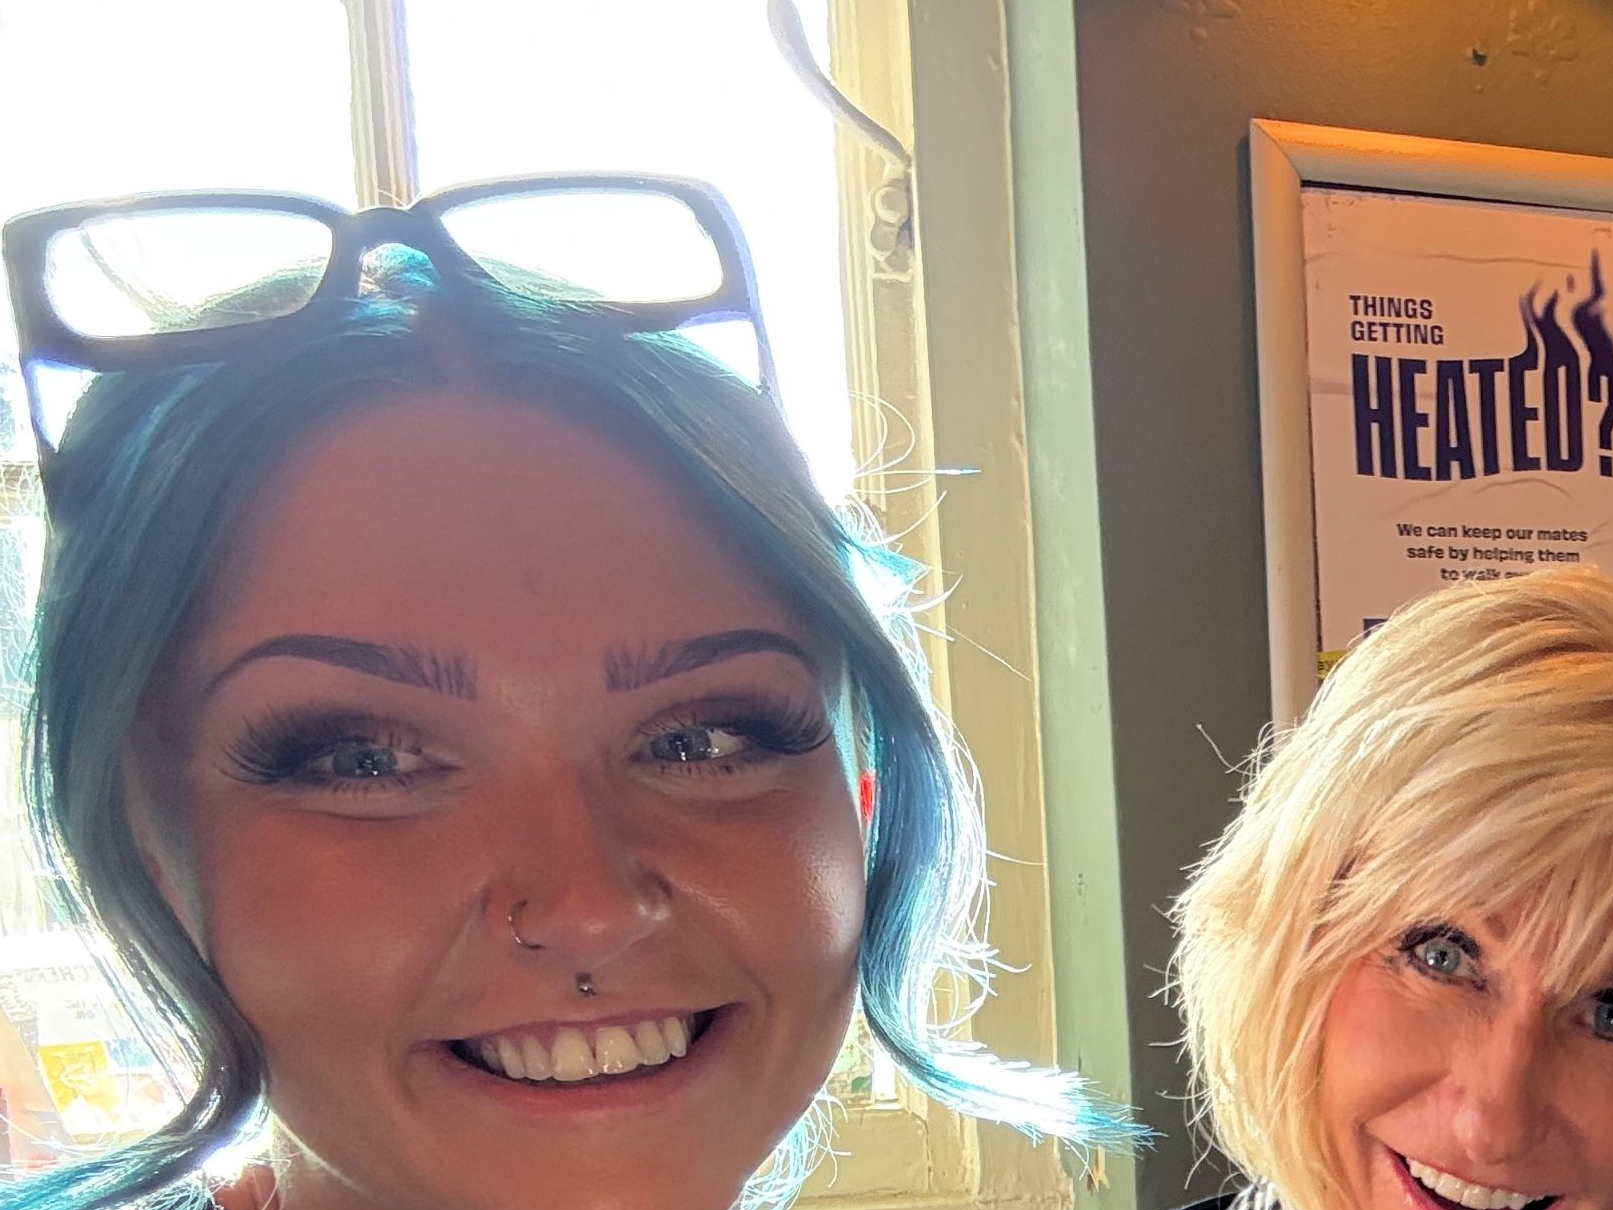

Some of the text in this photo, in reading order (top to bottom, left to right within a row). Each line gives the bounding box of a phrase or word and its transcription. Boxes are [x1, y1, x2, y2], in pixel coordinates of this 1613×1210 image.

[1349, 295, 1433, 320] THINGS
[1350, 320, 1444, 345] GETTING
[1396, 524, 1588, 542] We can keep our mates
[1406, 546, 1580, 564] safe by helping them
[1440, 567, 1459, 581] to
[1463, 568, 1501, 582] walk
